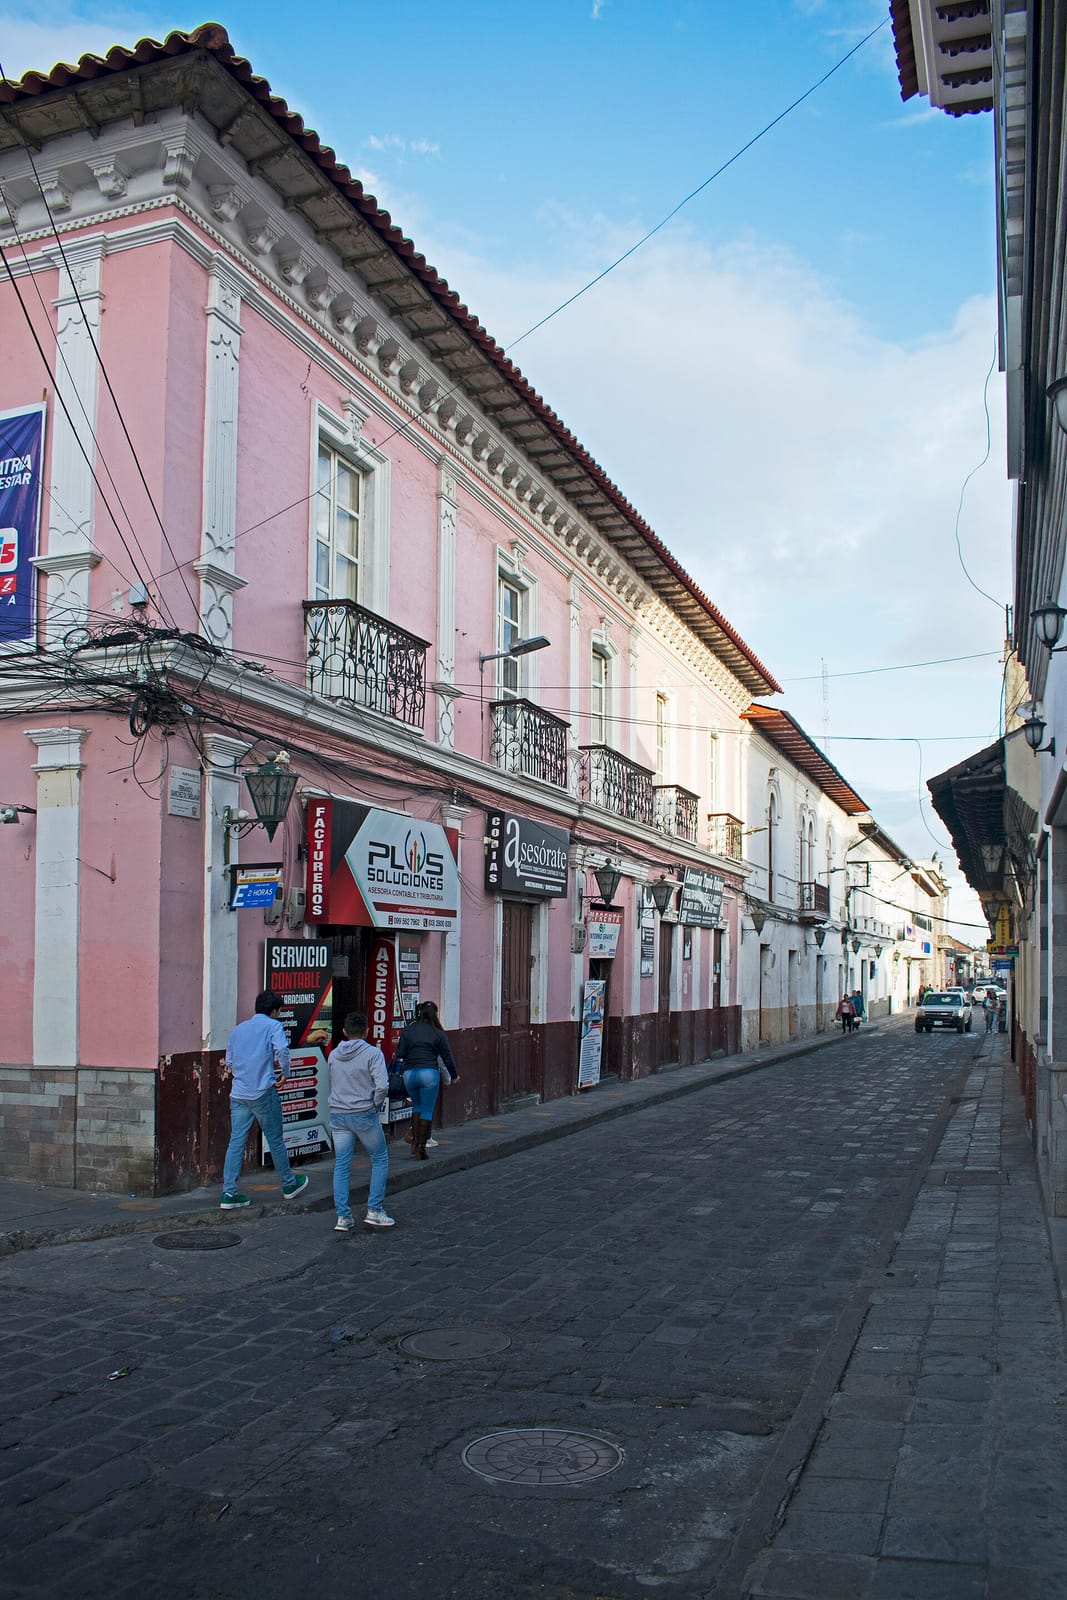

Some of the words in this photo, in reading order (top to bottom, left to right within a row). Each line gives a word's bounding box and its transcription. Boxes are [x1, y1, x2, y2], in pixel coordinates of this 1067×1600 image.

[312, 807, 326, 916] FACTUREROS
[367, 867, 444, 891] SOLUCIONES
[232, 884, 249, 907] E
[247, 889, 253, 897] 2
[252, 888, 273, 897] HORAS
[271, 945, 328, 968] SERVICIO
[271, 971, 321, 990] CONTABLE
[281, 993, 315, 1005] ARACIONES
